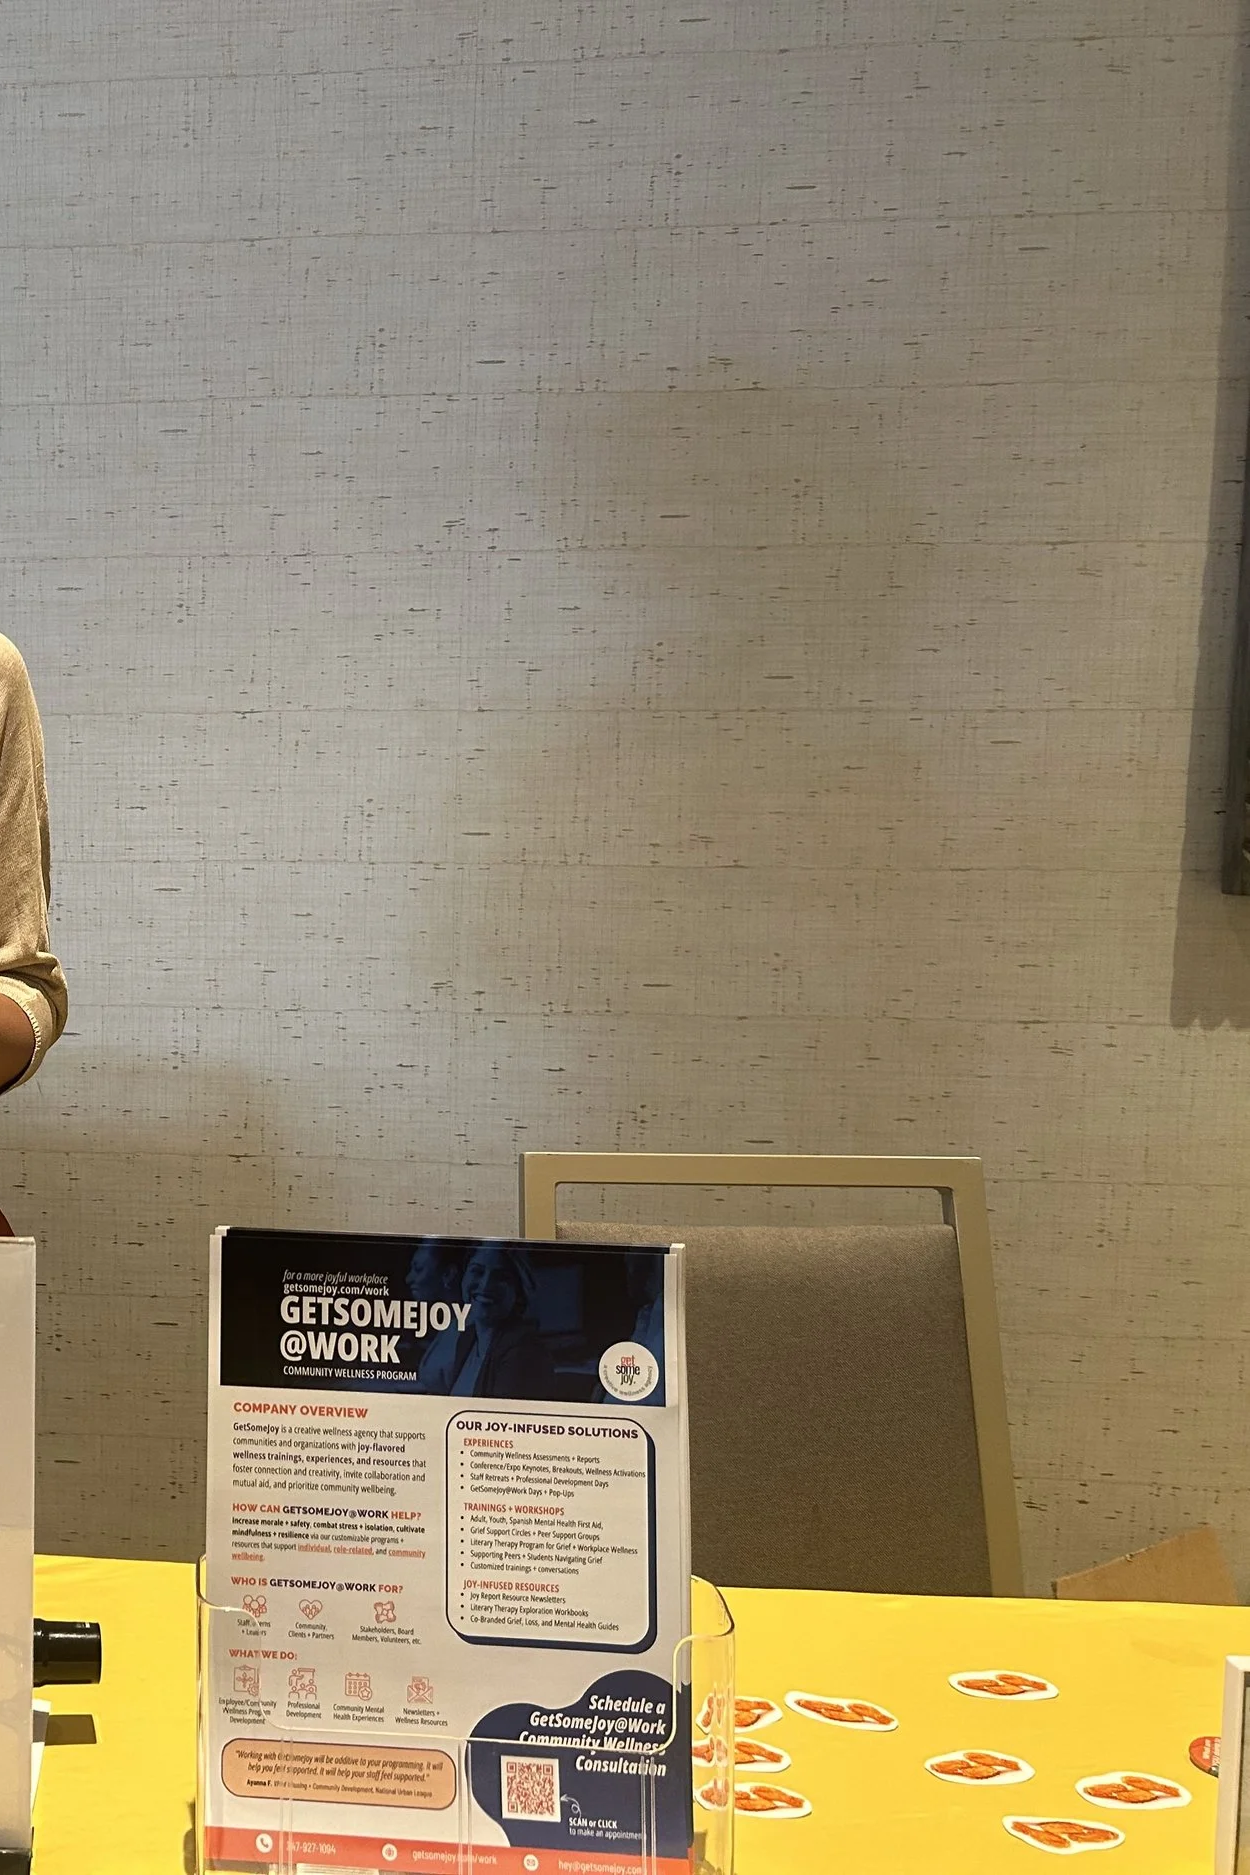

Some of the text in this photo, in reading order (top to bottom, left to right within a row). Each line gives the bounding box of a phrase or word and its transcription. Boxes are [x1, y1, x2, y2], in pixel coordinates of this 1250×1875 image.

[282, 1269, 296, 1283] for
[303, 1273, 324, 1282] more
[324, 1270, 348, 1285] joyful
[348, 1271, 389, 1286] workplace
[283, 1283, 390, 1298] getsomejoy.com/work
[280, 1295, 472, 1338] GETSOMEJOY
[280, 1330, 401, 1364] @WORK
[283, 1365, 417, 1381] COMMUNITY WELLNESS PROGRAM
[615, 1364, 641, 1376] some
[233, 1402, 369, 1419] COMPANY OVERVIEW
[233, 1422, 280, 1436] GetSomeJoy
[281, 1424, 287, 1434] is
[294, 1425, 321, 1435] creative
[322, 1426, 352, 1437] wellness
[353, 1429, 378, 1441] agency
[379, 1429, 393, 1439] that
[395, 1431, 426, 1442] supports
[456, 1420, 639, 1439] OUR JOY-INFUSED SOLUTIONS
[463, 1438, 514, 1449] EXPERIENCES
[232, 1450, 426, 1468] wellness trainings, experiences, and resources that
[470, 1450, 600, 1465] Community Wellness Assessments Reports
[232, 1502, 422, 1521] HOW CAN GETSOMEJOY@WORK HELP?
[463, 1502, 507, 1513] TRAININGS
[514, 1505, 565, 1516] WORKSHOPS
[230, 1576, 404, 1594] WHO IS GETSOMEJOY@WORK FOR?
[462, 1579, 560, 1593] JOY-INFUSED RESOURCES
[228, 1648, 298, 1661] WHAT WE DO:
[588, 1694, 667, 1715] Schedule a
[529, 1711, 667, 1736] GetSomeJoy@Work
[575, 1755, 668, 1778] Consultation
[568, 1817, 618, 1830] SCAN or CLICK
